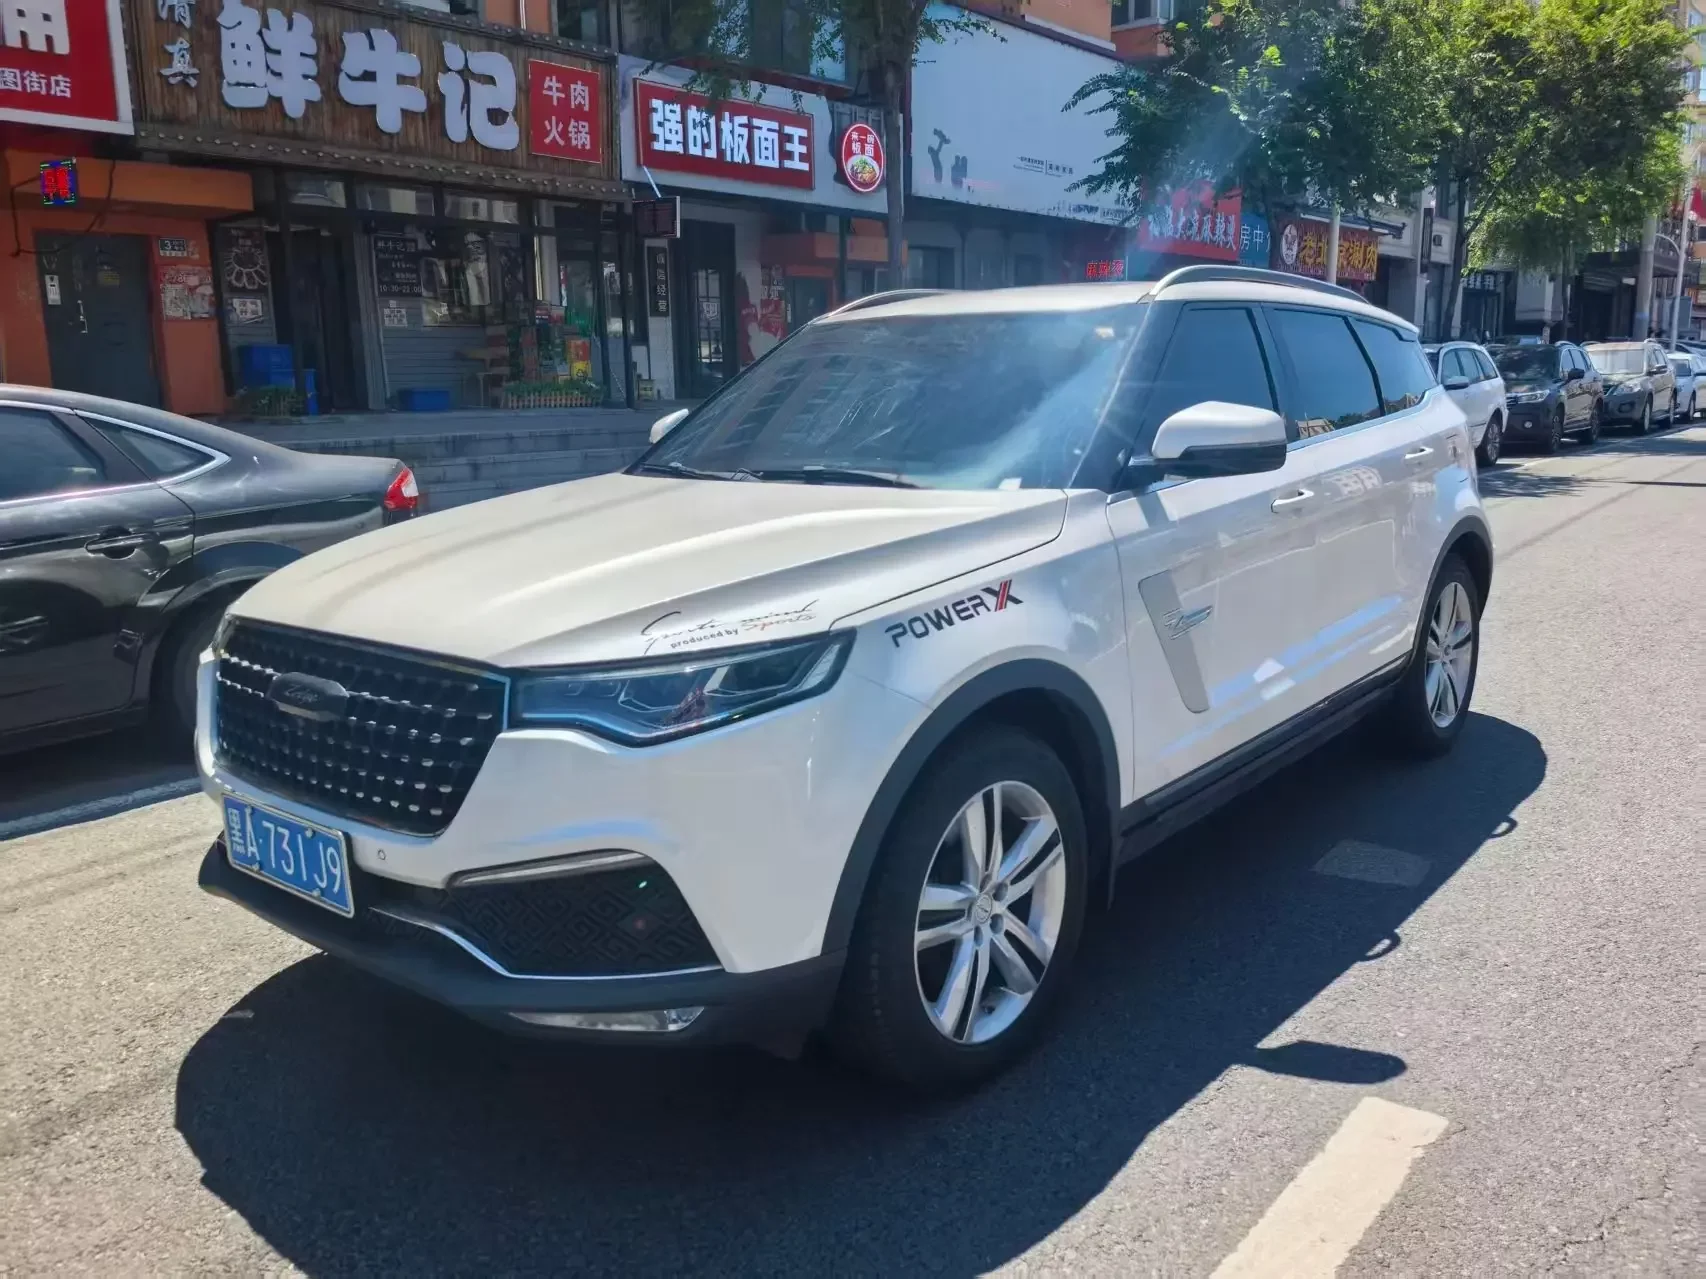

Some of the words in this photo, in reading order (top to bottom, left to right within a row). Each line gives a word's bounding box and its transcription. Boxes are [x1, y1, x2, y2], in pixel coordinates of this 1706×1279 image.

[216, 0, 520, 151] 鲜牛记
[542, 76, 590, 112] 牛肉
[543, 115, 592, 150] 火锅
[650, 98, 810, 172] 强的板面王
[670, 630, 724, 650] produced
[724, 626, 740, 637] by
